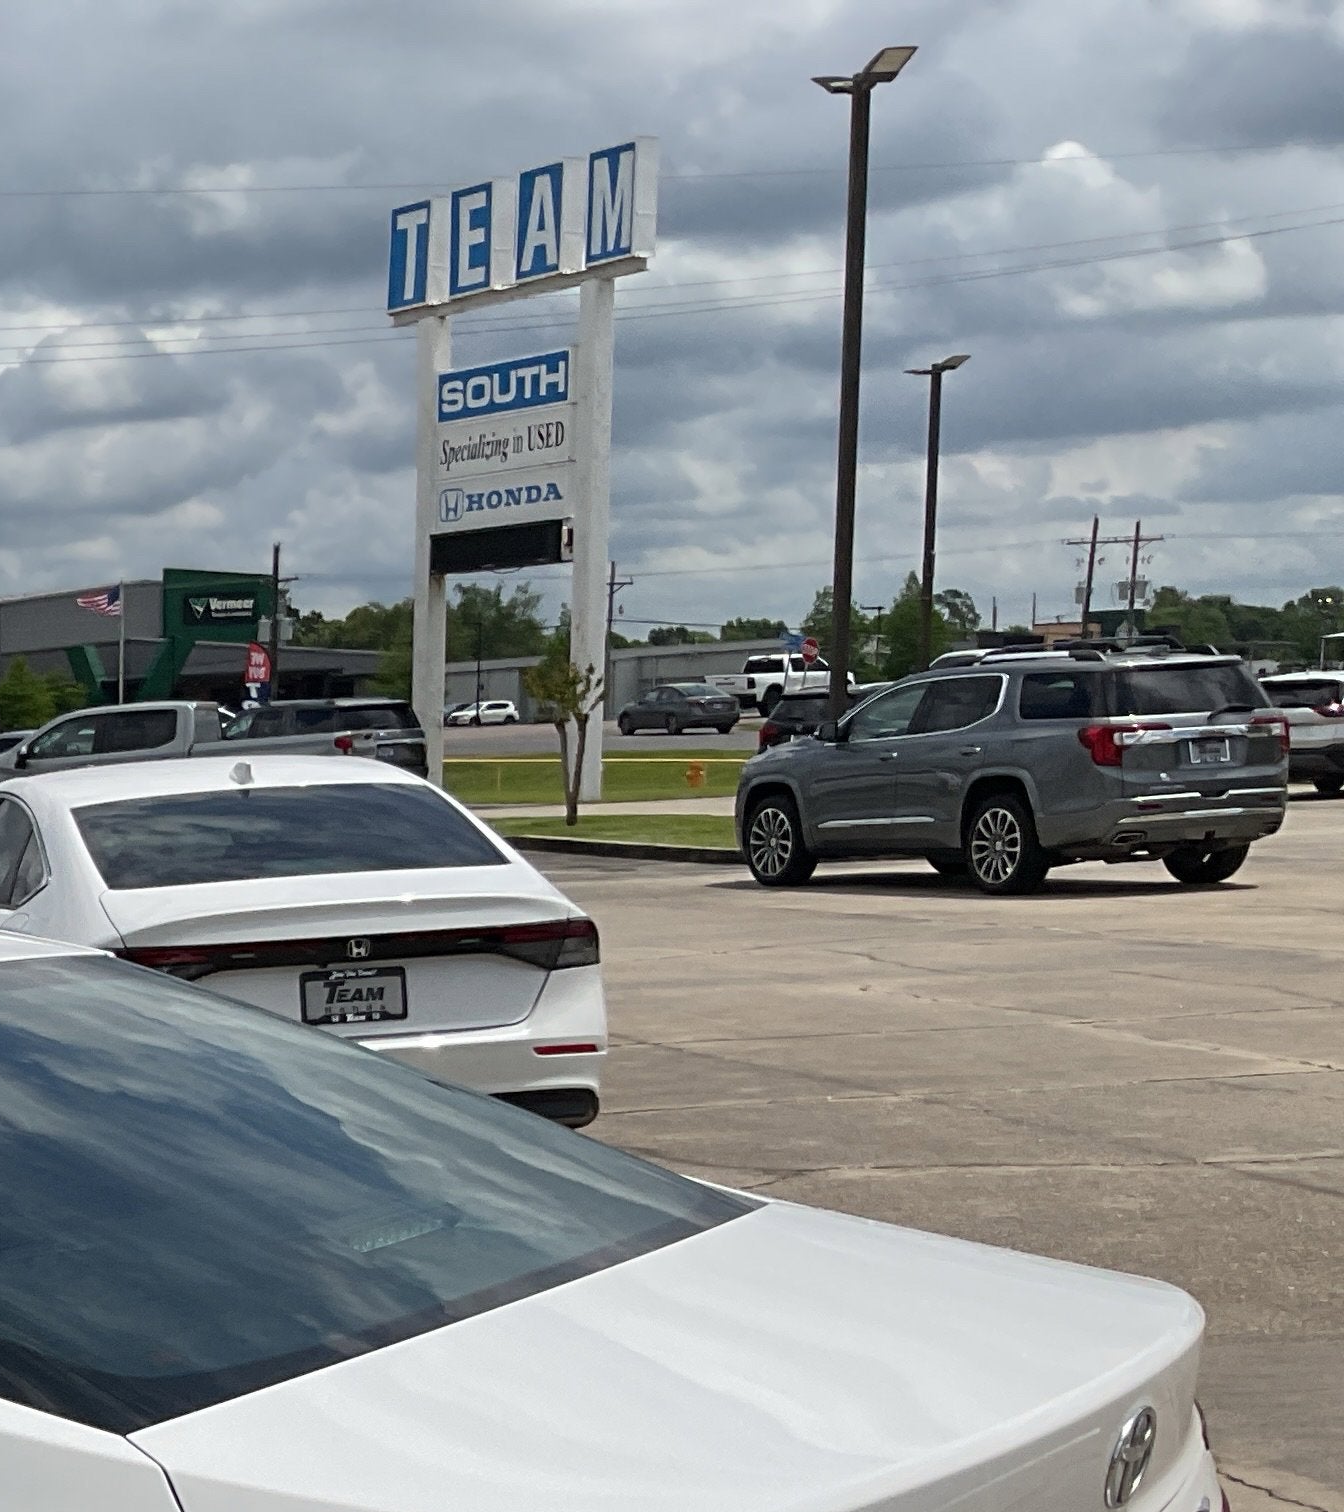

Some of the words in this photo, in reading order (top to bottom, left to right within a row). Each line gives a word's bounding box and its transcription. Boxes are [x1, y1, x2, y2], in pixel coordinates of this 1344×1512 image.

[395, 150, 635, 301] TEAM
[440, 360, 565, 414] SOUTH
[440, 428, 510, 470] Specializing
[512, 431, 524, 455] in
[527, 420, 565, 451] USED
[465, 482, 562, 512] HONDA
[323, 980, 385, 1004] TEAM
